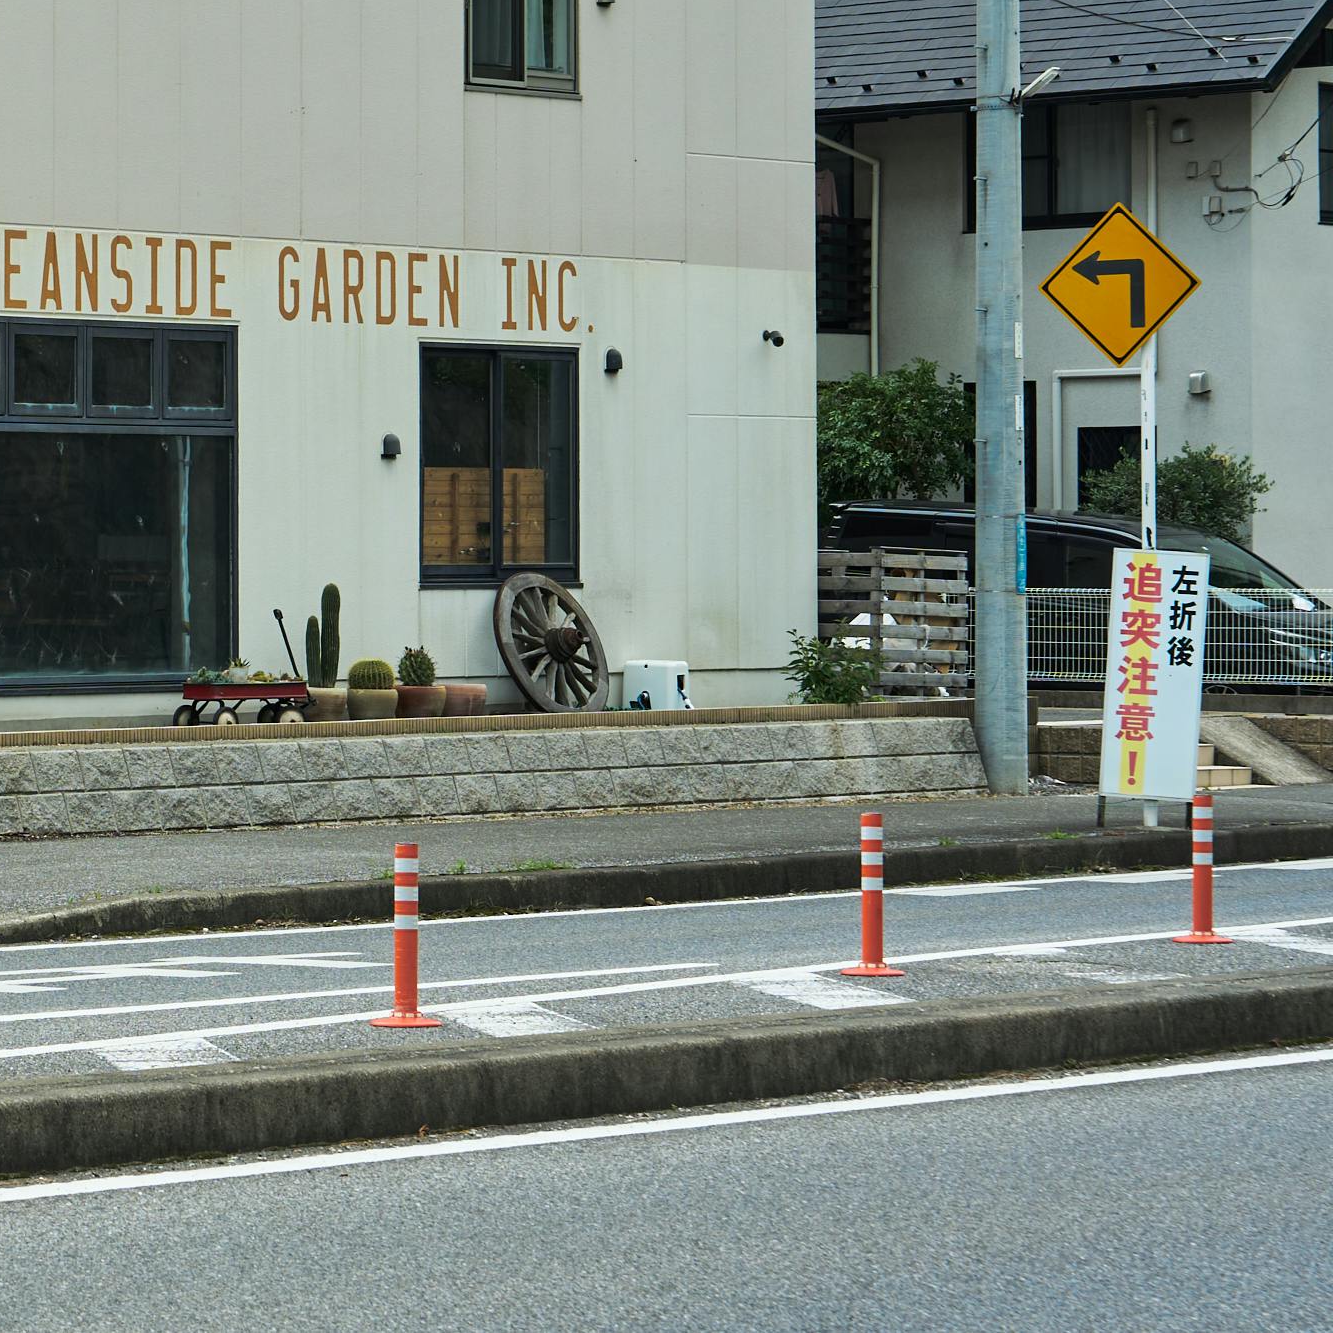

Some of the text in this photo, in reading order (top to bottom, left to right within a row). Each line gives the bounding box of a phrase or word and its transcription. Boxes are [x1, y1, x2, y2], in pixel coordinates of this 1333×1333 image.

[278, 246, 459, 328] GARDEN
[501, 257, 594, 333] INC.
[1167, 565, 1199, 667] 左折後
